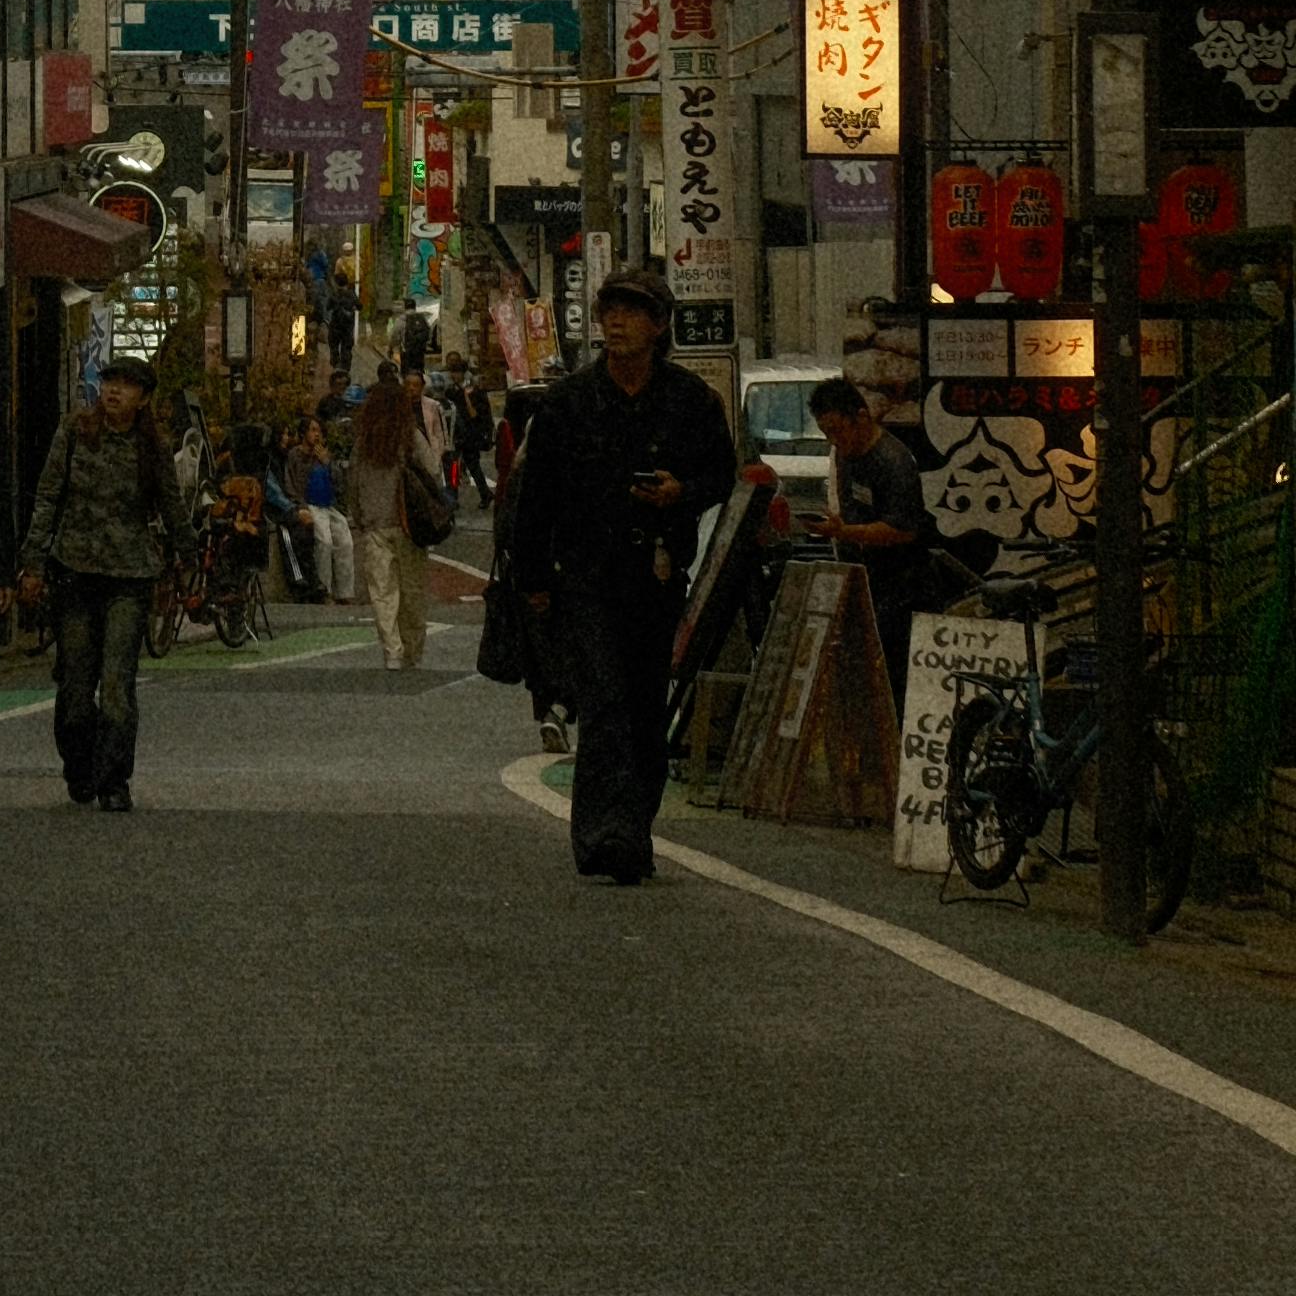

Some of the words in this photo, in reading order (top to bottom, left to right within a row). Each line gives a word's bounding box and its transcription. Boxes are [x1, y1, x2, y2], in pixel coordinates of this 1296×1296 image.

[276, 29, 341, 101] 祭
[323, 149, 365, 193] 祭
[680, 86, 721, 235] ともえや
[686, 327, 724, 342] 2-12
[1022, 336, 1085, 358] ランチ
[933, 626, 999, 649] CITY
[912, 650, 1028, 679] COUNTRY
